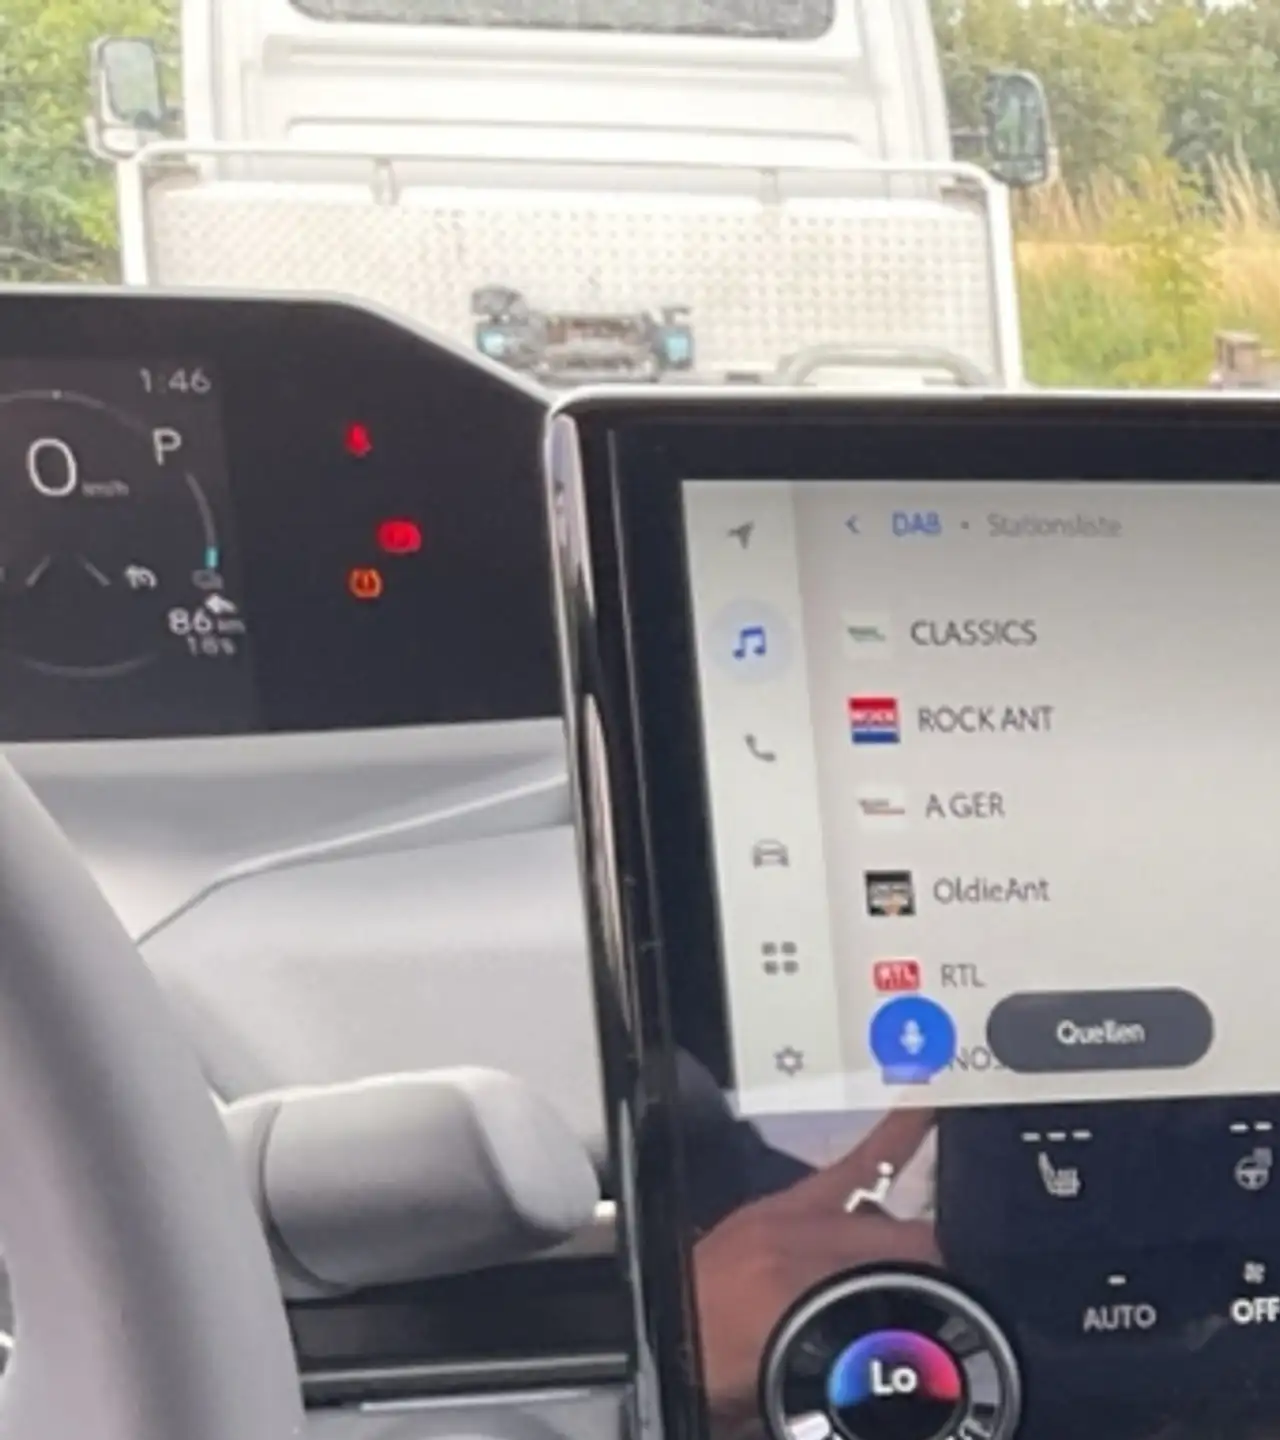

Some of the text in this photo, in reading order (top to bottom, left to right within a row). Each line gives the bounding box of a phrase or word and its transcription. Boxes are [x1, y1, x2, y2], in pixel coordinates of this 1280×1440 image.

[140, 369, 212, 394] 1:46
[152, 427, 182, 466] P
[26, 437, 77, 496] 0
[892, 511, 1123, 537] DAB Stationsliste
[168, 607, 213, 635] 86
[909, 618, 1038, 647] CLASSICS
[917, 704, 1055, 734] ROCK ANT
[950, 791, 1005, 819] GER
[933, 876, 1051, 905] OldieAnt
[940, 963, 986, 989] RTL
[1056, 1018, 1147, 1045] Quellen
[1083, 1303, 1157, 1333] AUTO
[870, 1360, 918, 1395] Lo
